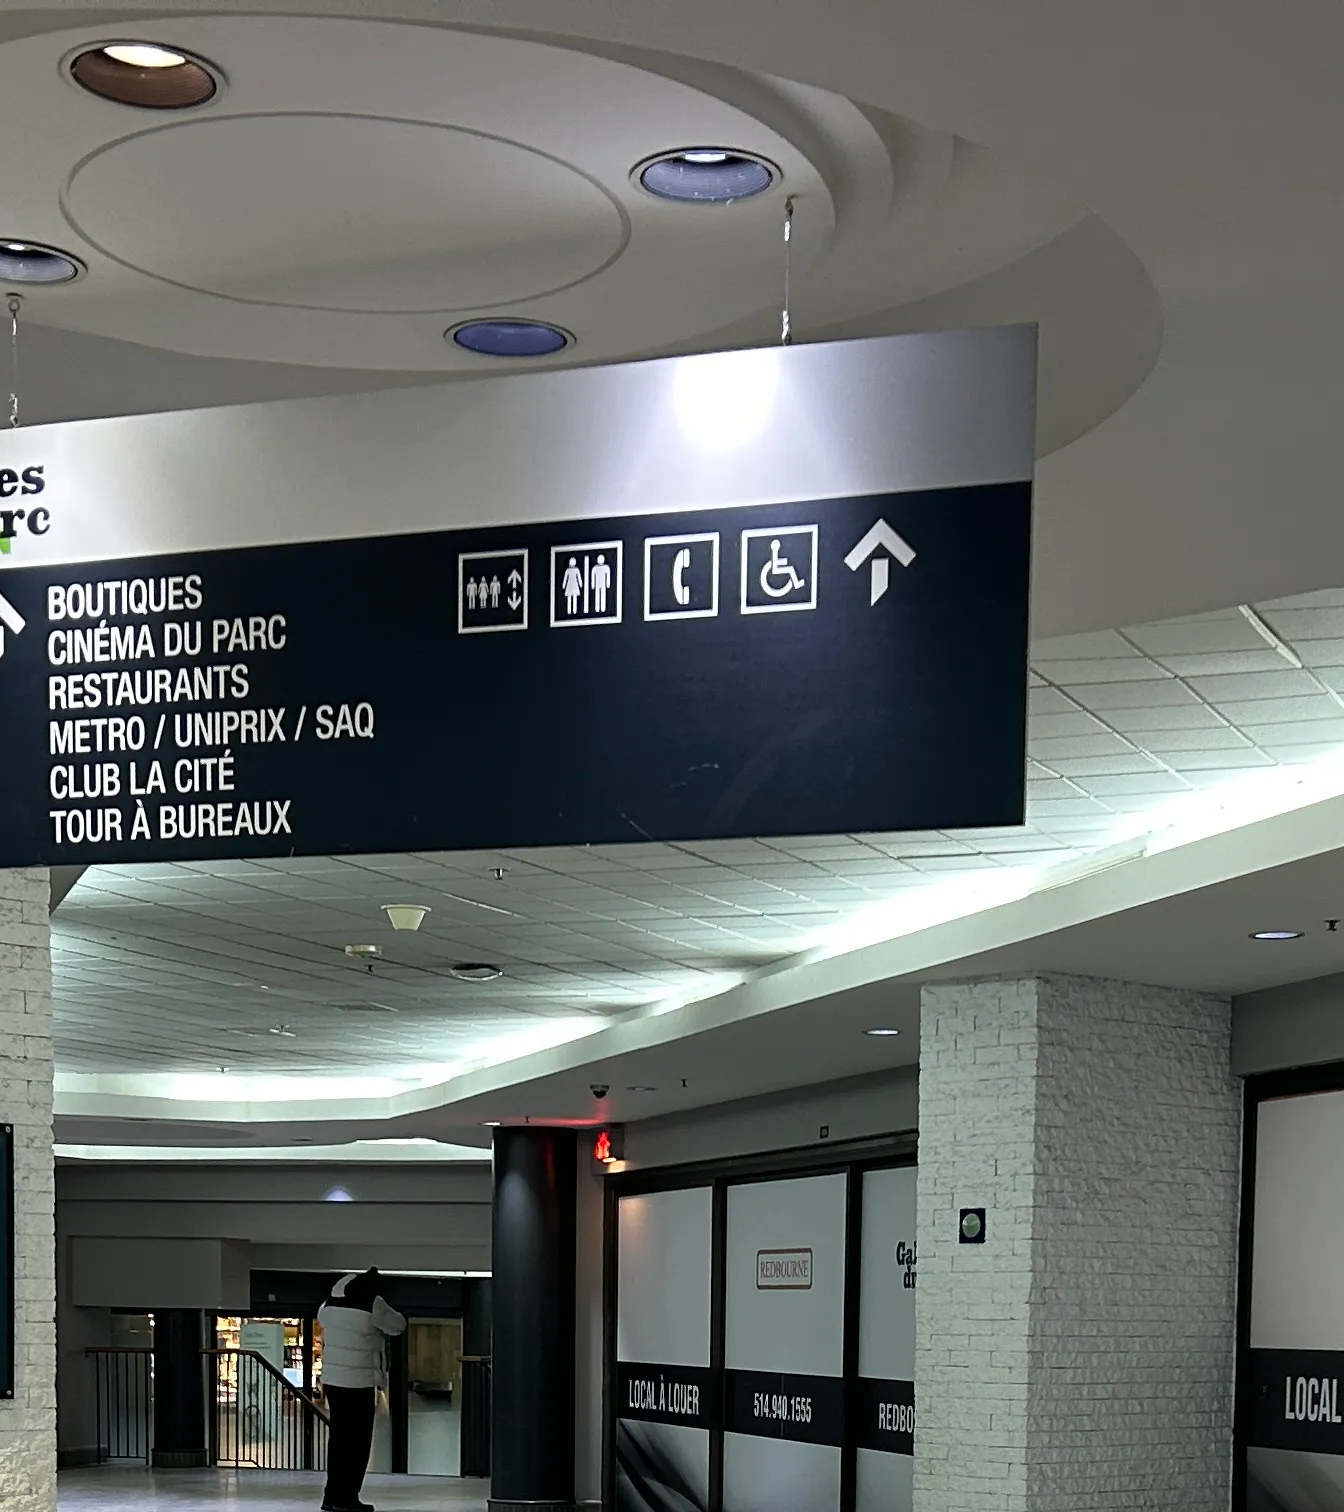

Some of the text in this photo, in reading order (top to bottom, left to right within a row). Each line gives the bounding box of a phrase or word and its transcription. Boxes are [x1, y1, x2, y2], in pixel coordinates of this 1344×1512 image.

[48, 574, 203, 620] BOUTIQUES
[48, 614, 287, 665] CINÉMA DU PARC
[49, 664, 249, 710] RESTAURANTS
[49, 716, 146, 754] METRO
[174, 707, 286, 748] UNIPRIX
[316, 702, 375, 740] SAQ
[50, 749, 235, 799] CLUB LA CITÉ
[49, 800, 293, 844] TOUR À BUREAUX
[760, 1260, 809, 1279] REDBOURNE
[629, 1374, 700, 1415] LOCAL À LOUER
[754, 1392, 812, 1423] 514.940.1555
[878, 1402, 914, 1433] REDBO
[1285, 1376, 1342, 1423] LOCAL
